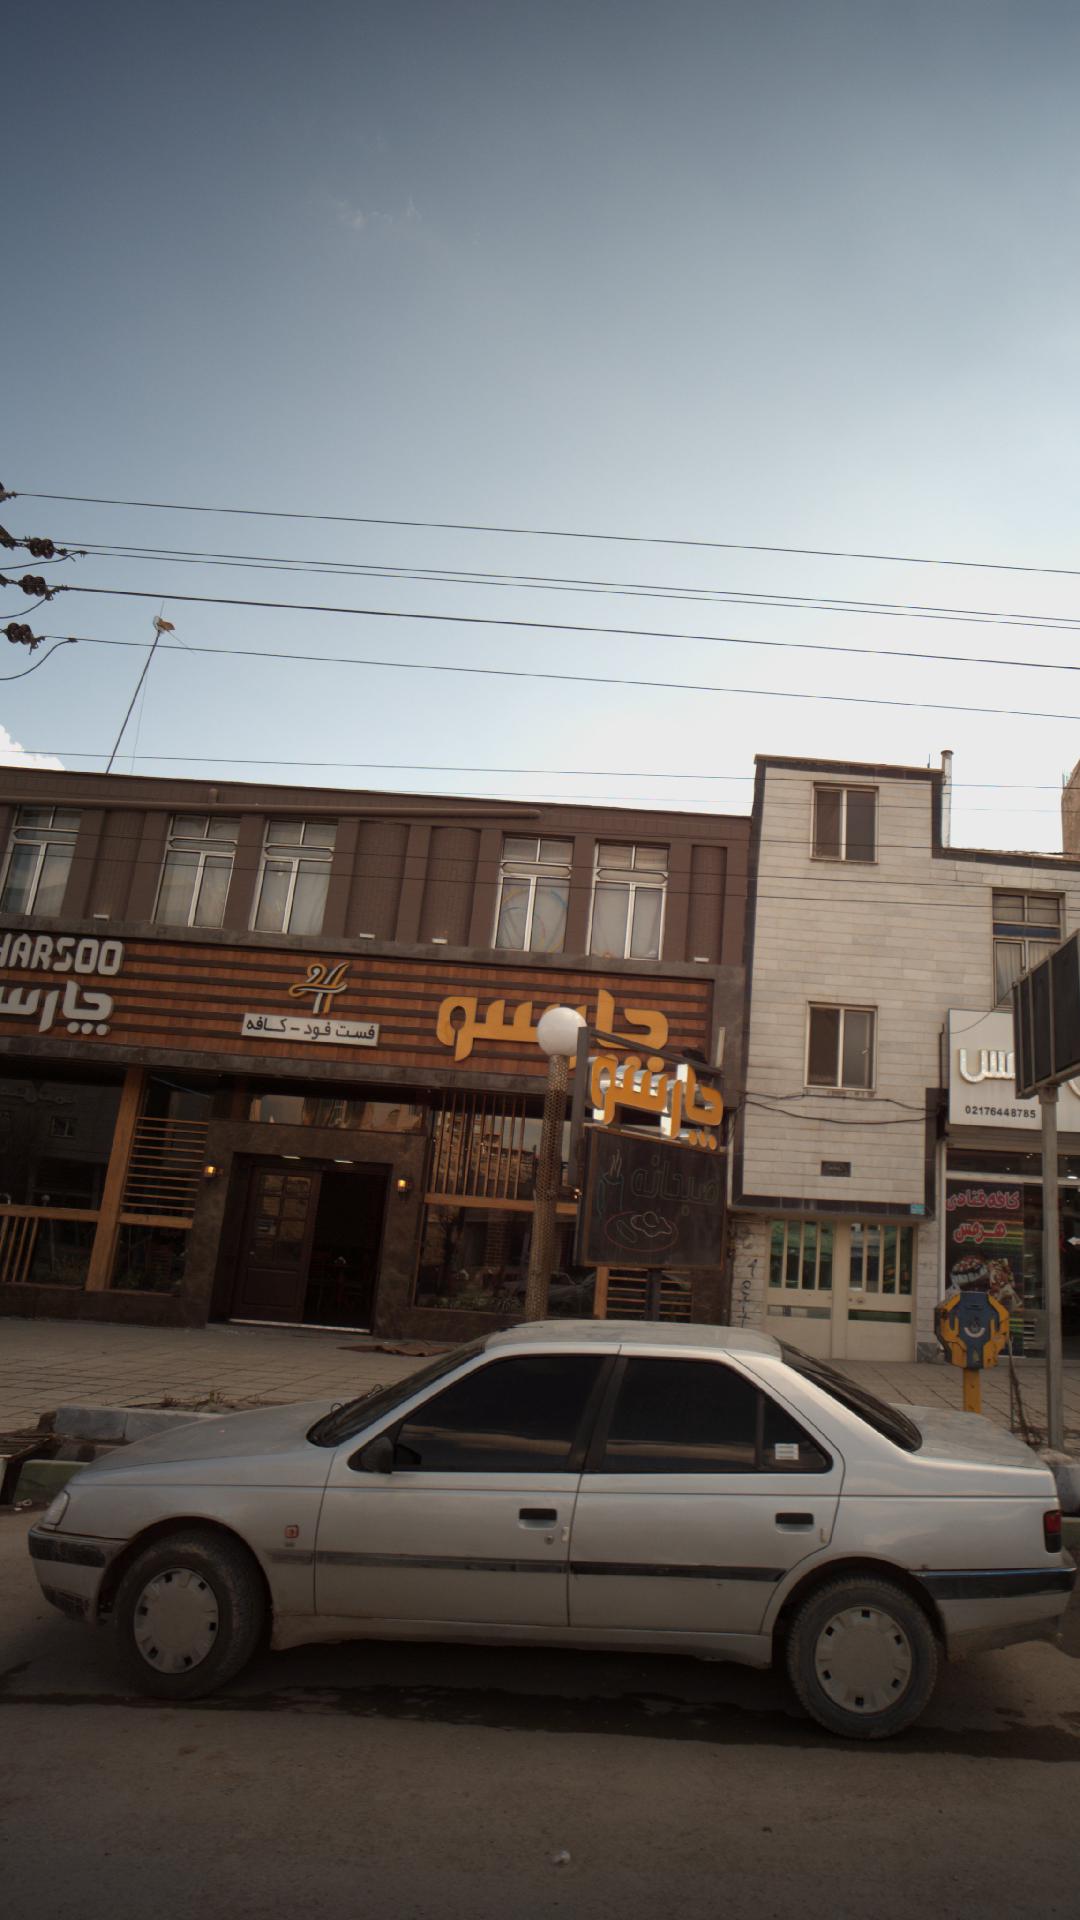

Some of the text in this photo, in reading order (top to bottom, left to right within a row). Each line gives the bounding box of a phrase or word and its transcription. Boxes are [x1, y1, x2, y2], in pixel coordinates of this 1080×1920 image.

[246, 1016, 287, 1033] کافه
[303, 1021, 331, 1040] فود
[335, 1023, 376, 1040] فست
[591, 1055, 724, 1150] چارسو
[965, 1105, 1036, 1119] 02176448785
[987, 1191, 1020, 1210] کافه
